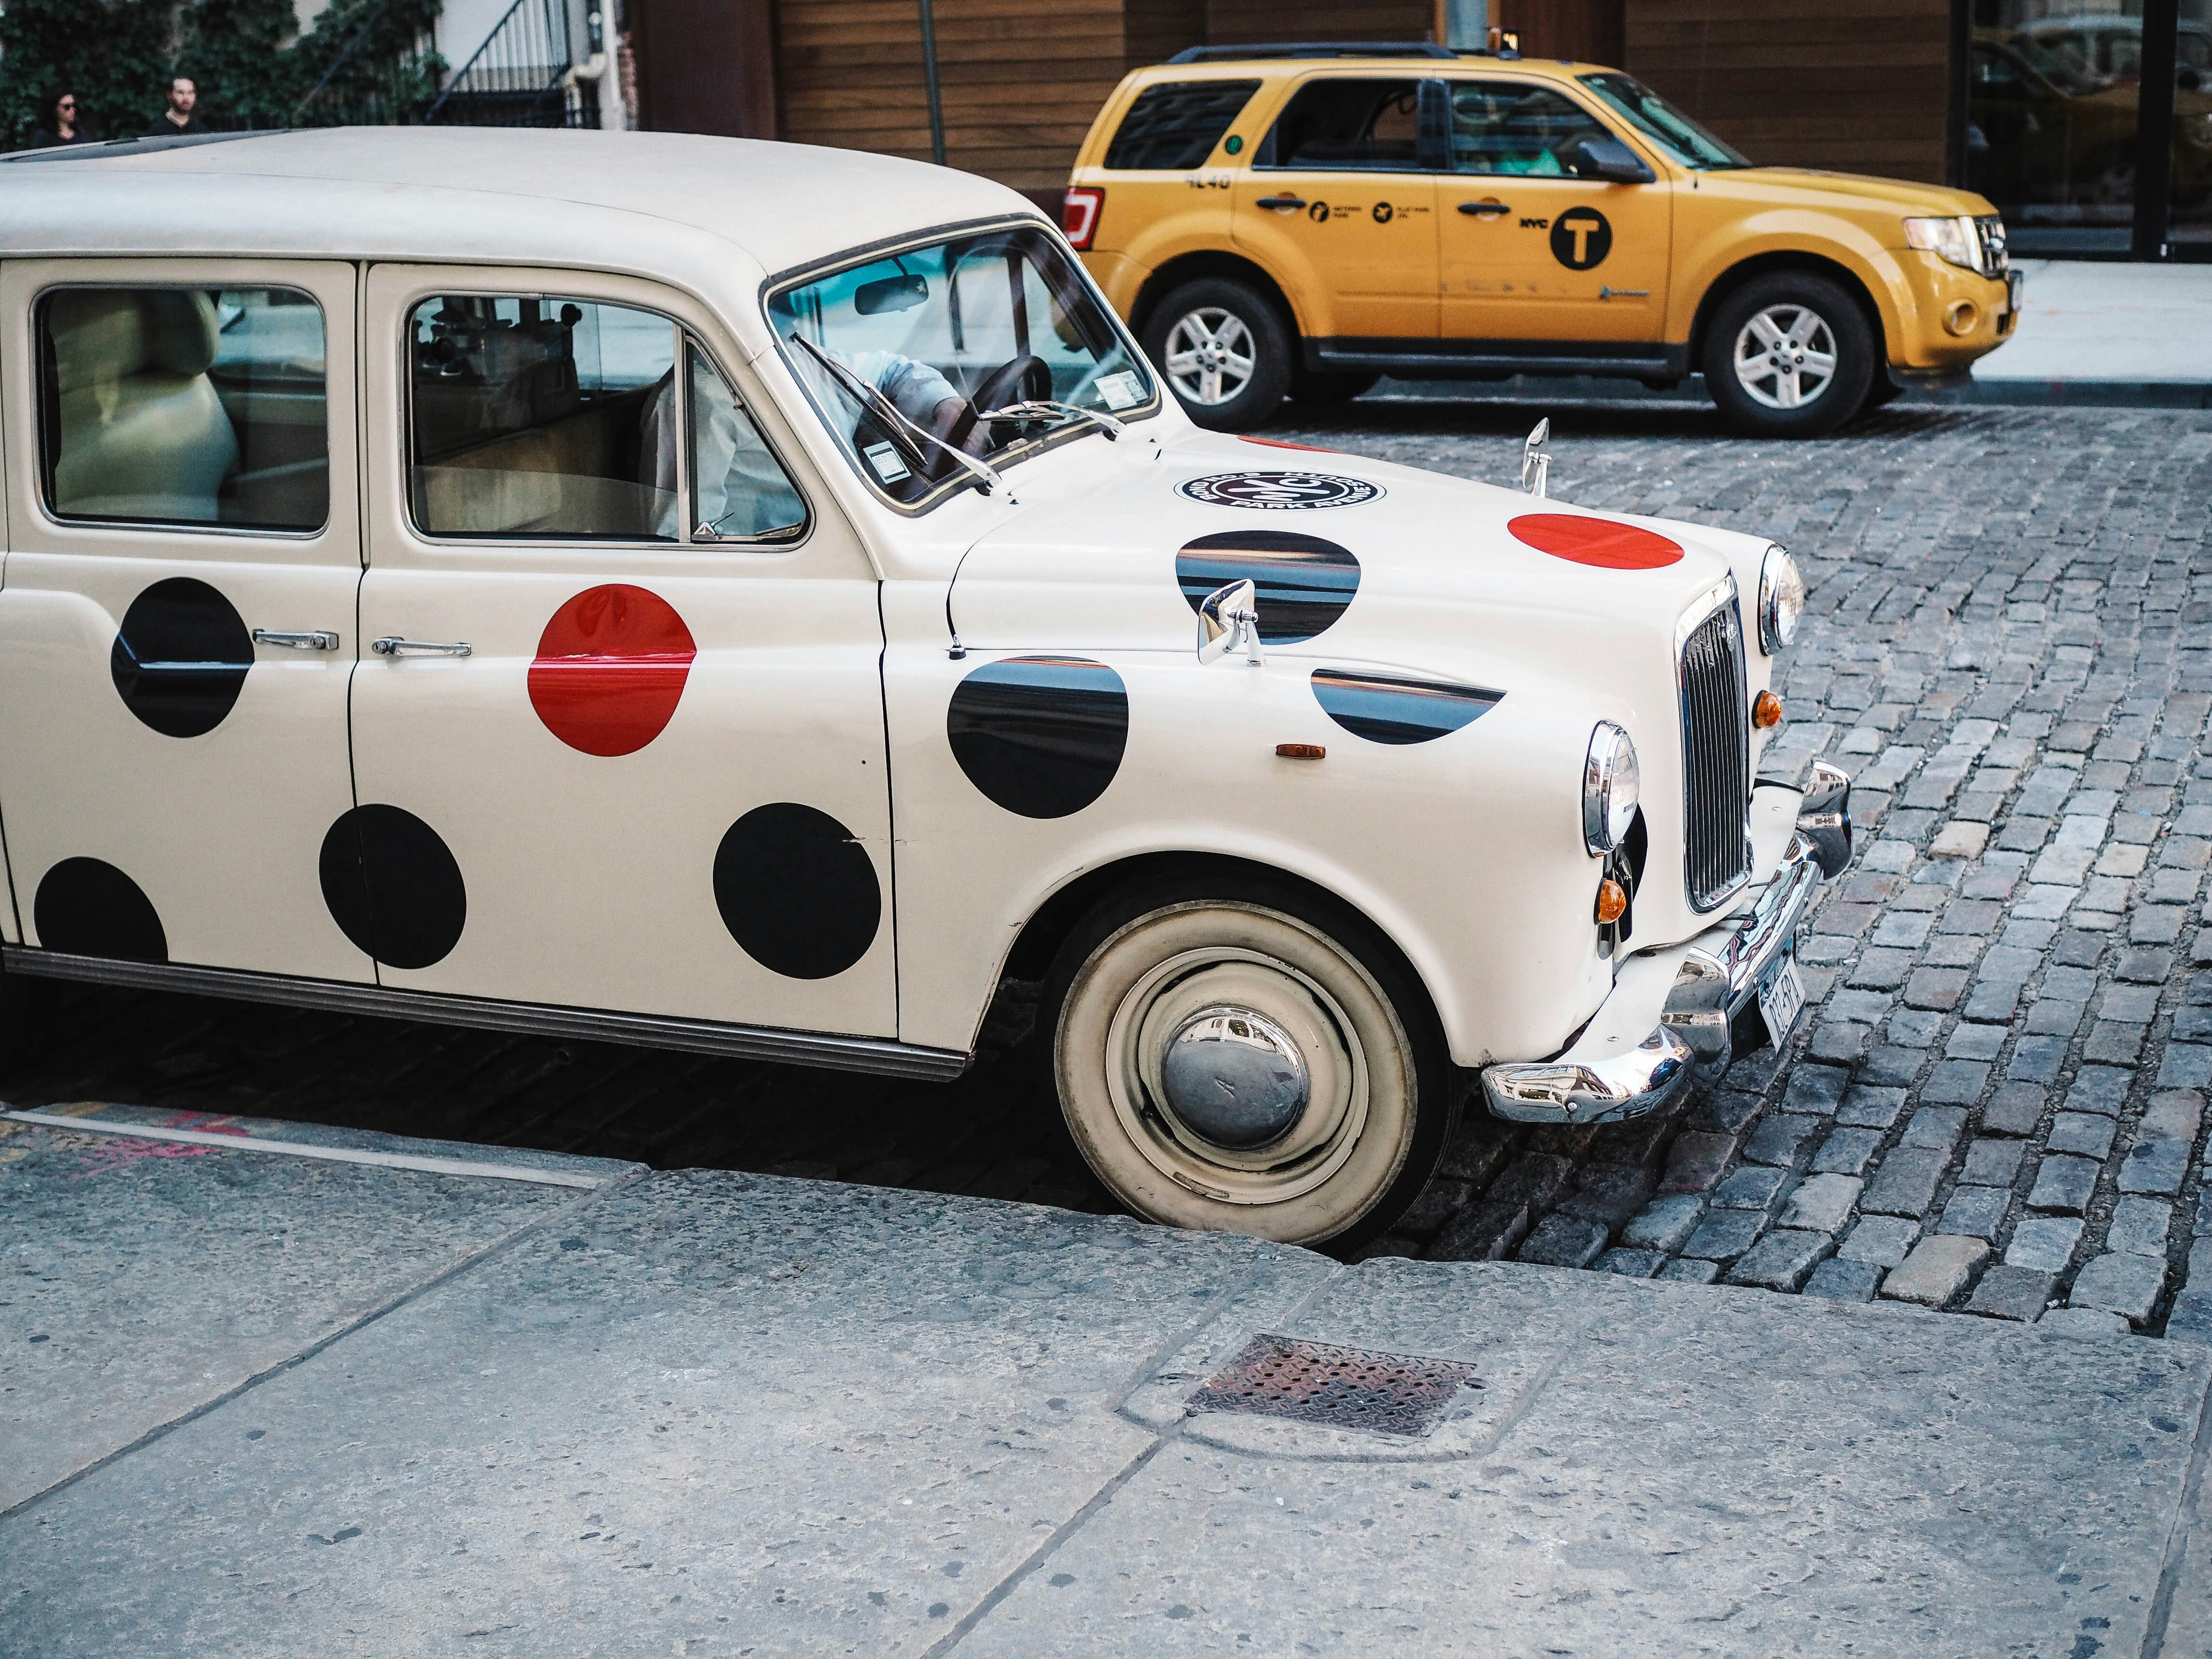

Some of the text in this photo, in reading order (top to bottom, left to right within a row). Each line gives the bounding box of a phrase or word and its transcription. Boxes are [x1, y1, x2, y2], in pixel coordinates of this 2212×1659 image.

[1520, 218, 1600, 264] NYC T
[1189, 481, 1220, 500] BOND
[1229, 472, 1371, 509] PARK AVENUE SOUTH
